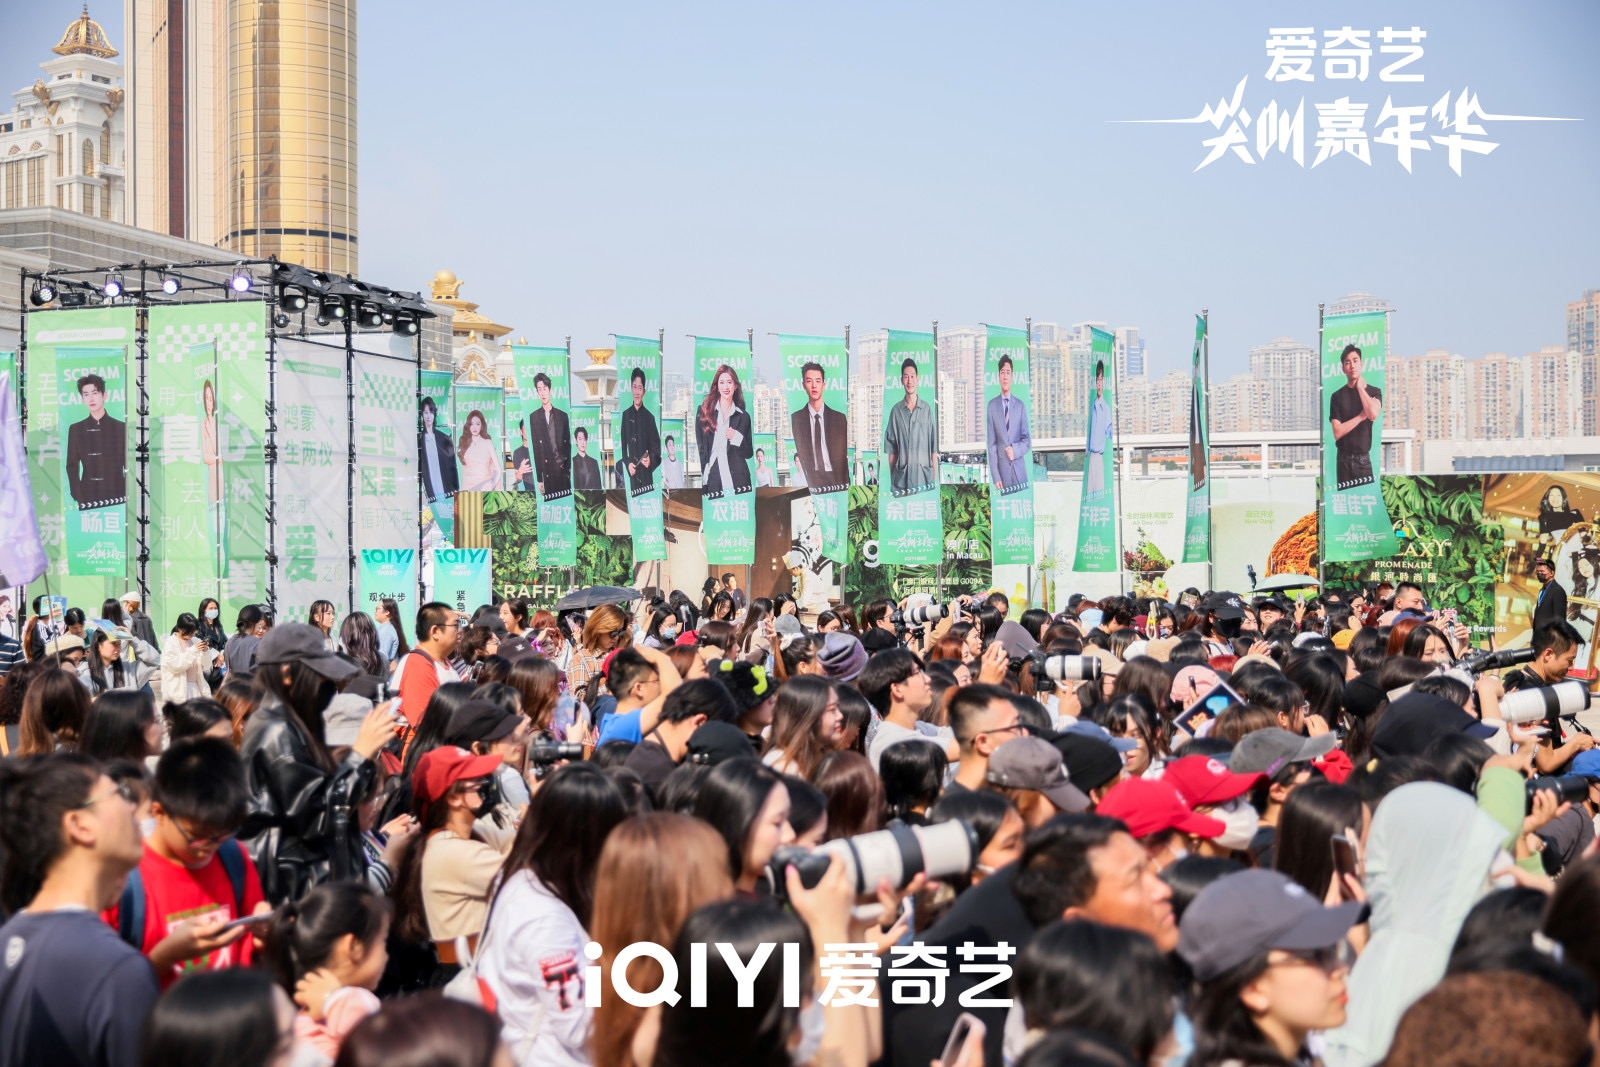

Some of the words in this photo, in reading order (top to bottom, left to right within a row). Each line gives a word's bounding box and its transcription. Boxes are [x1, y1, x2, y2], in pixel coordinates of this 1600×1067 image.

[1328, 331, 1378, 352] SCREAM
[621, 356, 655, 369] SCREAM
[63, 365, 120, 383] SCREAM
[456, 401, 495, 412] SCREAM
[284, 402, 316, 432] 鸿蒙
[360, 424, 397, 457] 三世
[284, 438, 333, 468] 生两仪
[360, 465, 397, 497] 因果
[540, 504, 572, 524] 杨旭文
[160, 513, 258, 541] 别人人
[947, 539, 979, 550] 澳门店
[362, 549, 414, 563] iQIYI
[435, 549, 488, 563] iQIYI
[1375, 560, 1433, 569] PROMENADE
